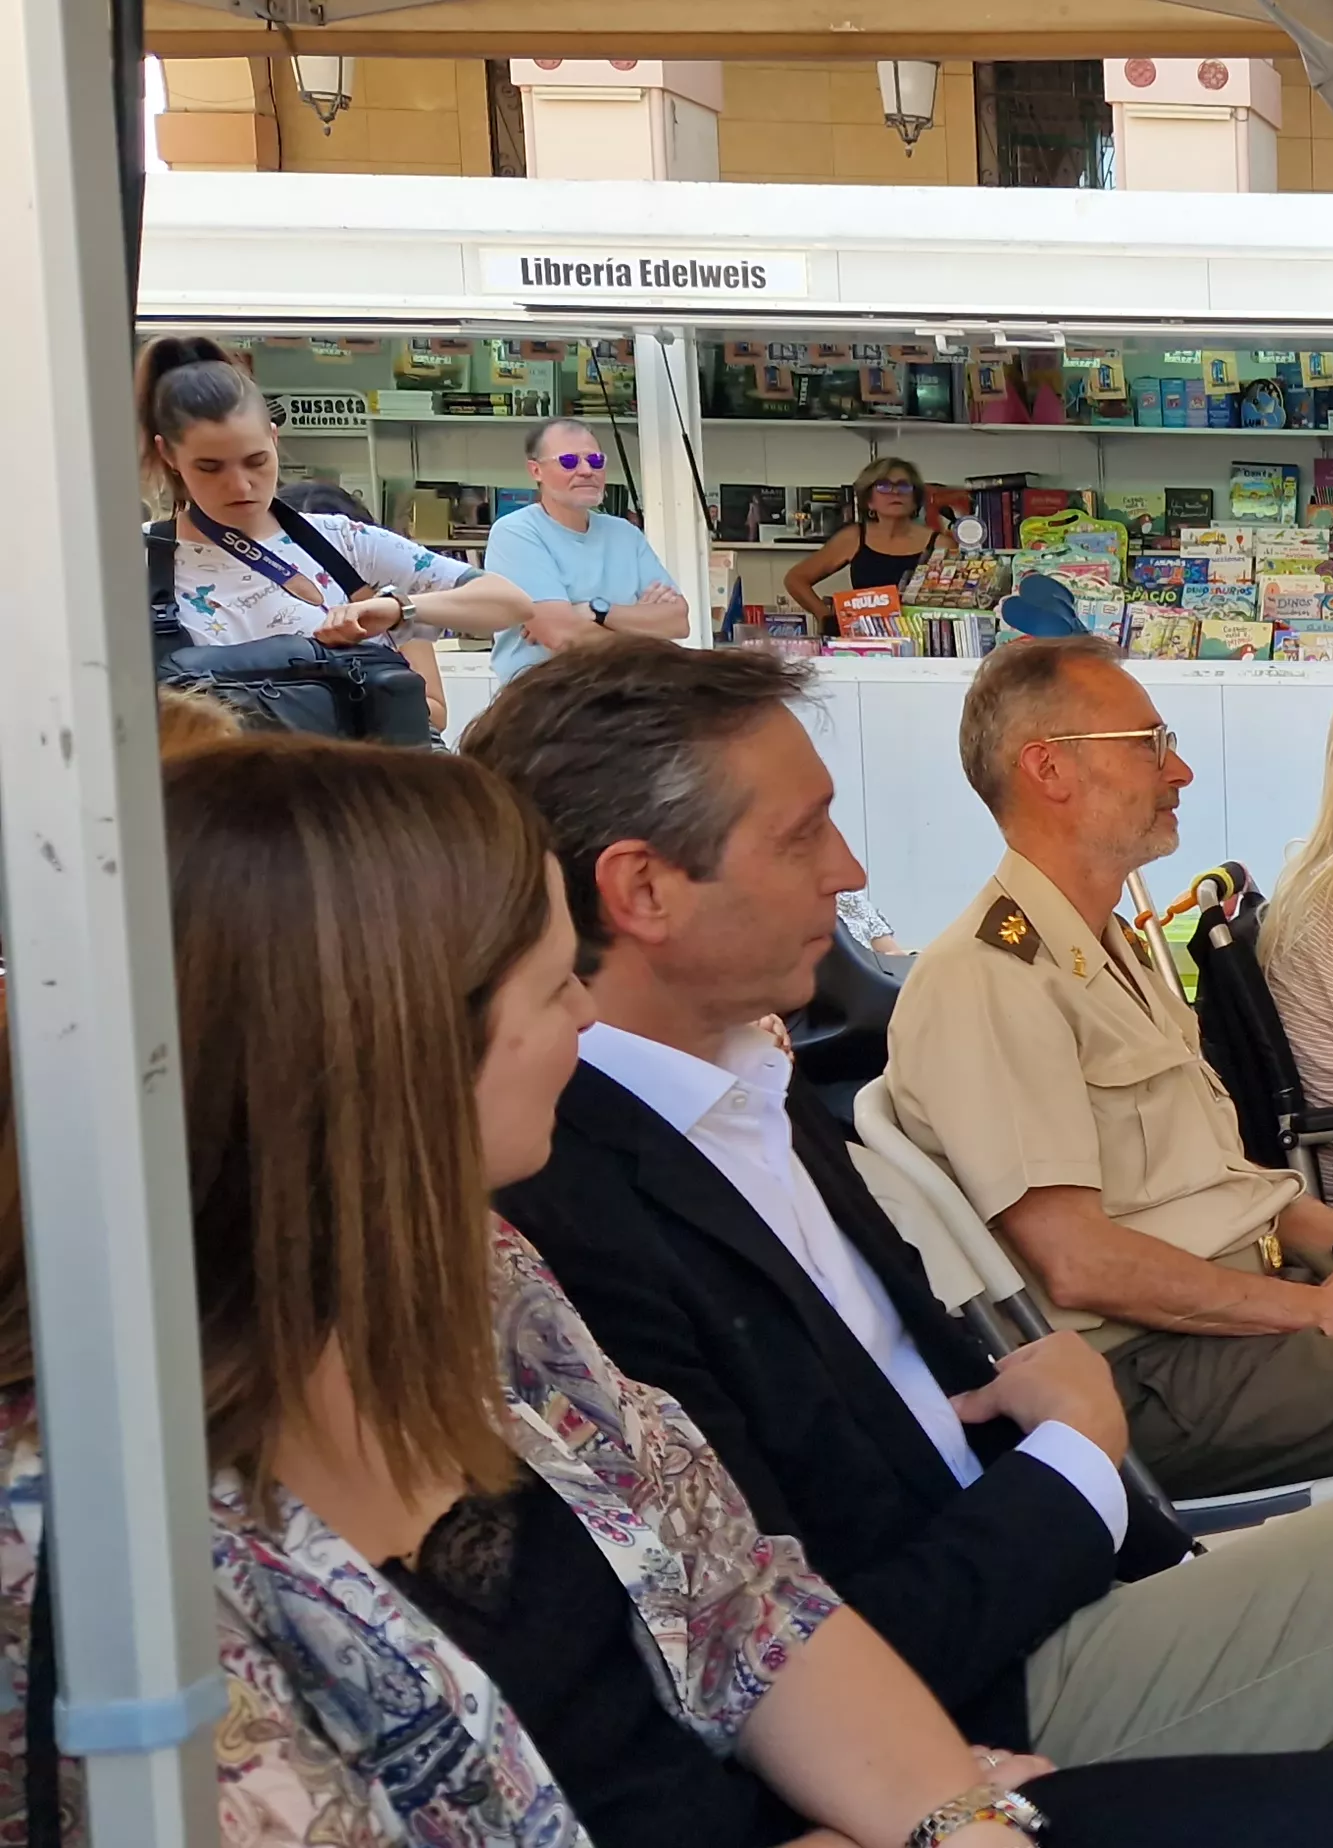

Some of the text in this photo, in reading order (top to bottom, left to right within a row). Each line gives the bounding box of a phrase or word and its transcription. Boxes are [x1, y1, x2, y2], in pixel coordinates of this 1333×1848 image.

[520, 257, 767, 289] Librería Edelweis
[290, 398, 366, 414] susaeta
[291, 415, 350, 426] ediciones
[221, 531, 263, 561] EOS
[1124, 589, 1177, 603] SPACIO
